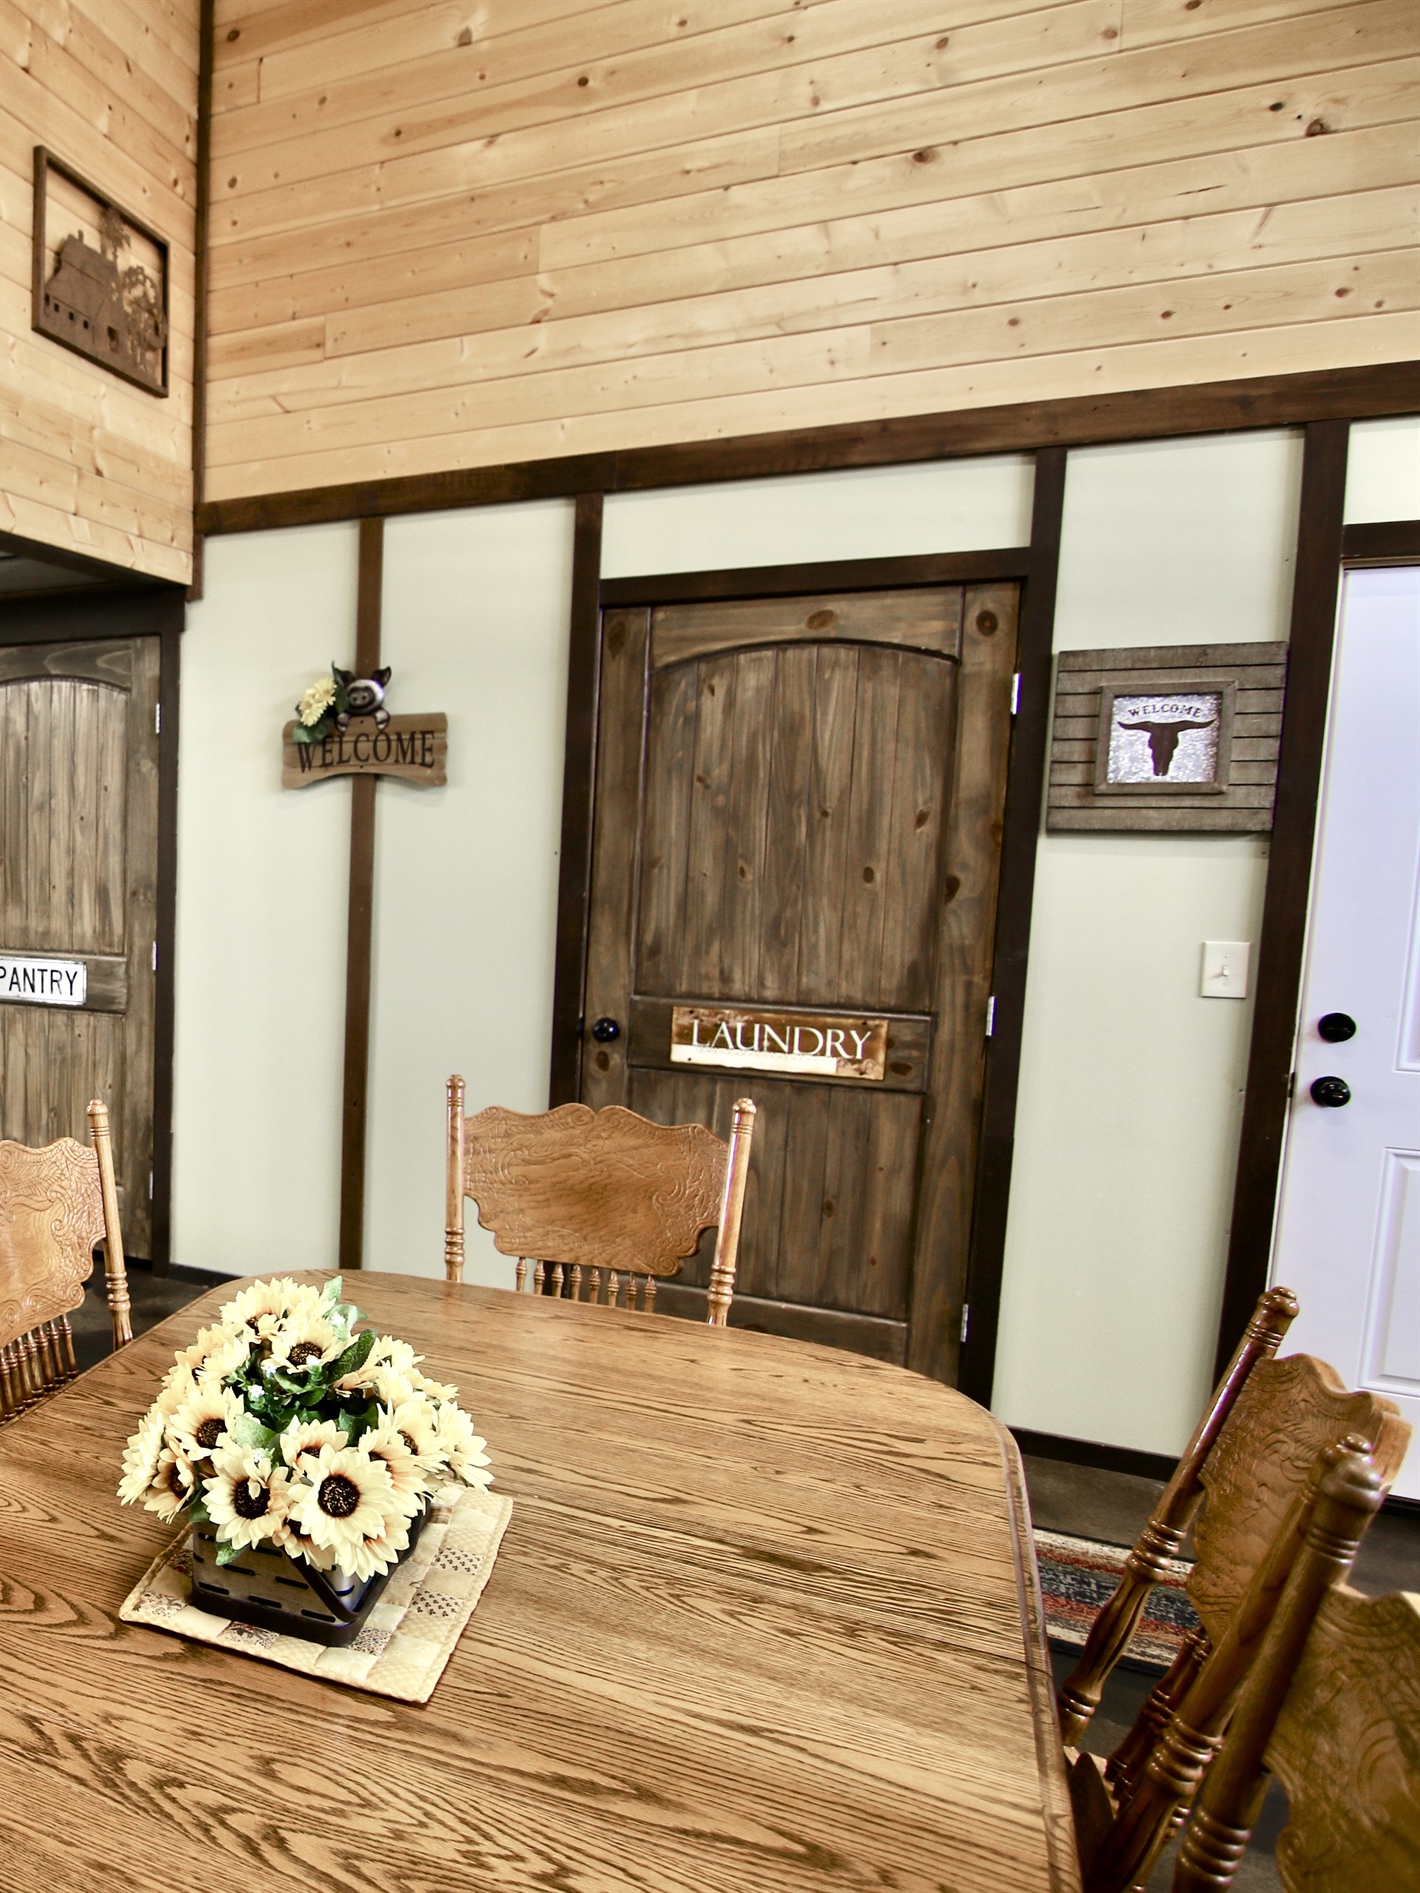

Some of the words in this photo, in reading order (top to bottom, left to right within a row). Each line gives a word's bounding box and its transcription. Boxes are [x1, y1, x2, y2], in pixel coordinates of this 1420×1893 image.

[1128, 703, 1203, 717] WELCOME
[296, 730, 436, 773] WELCOME
[691, 1018, 872, 1060] LAUNDRY
